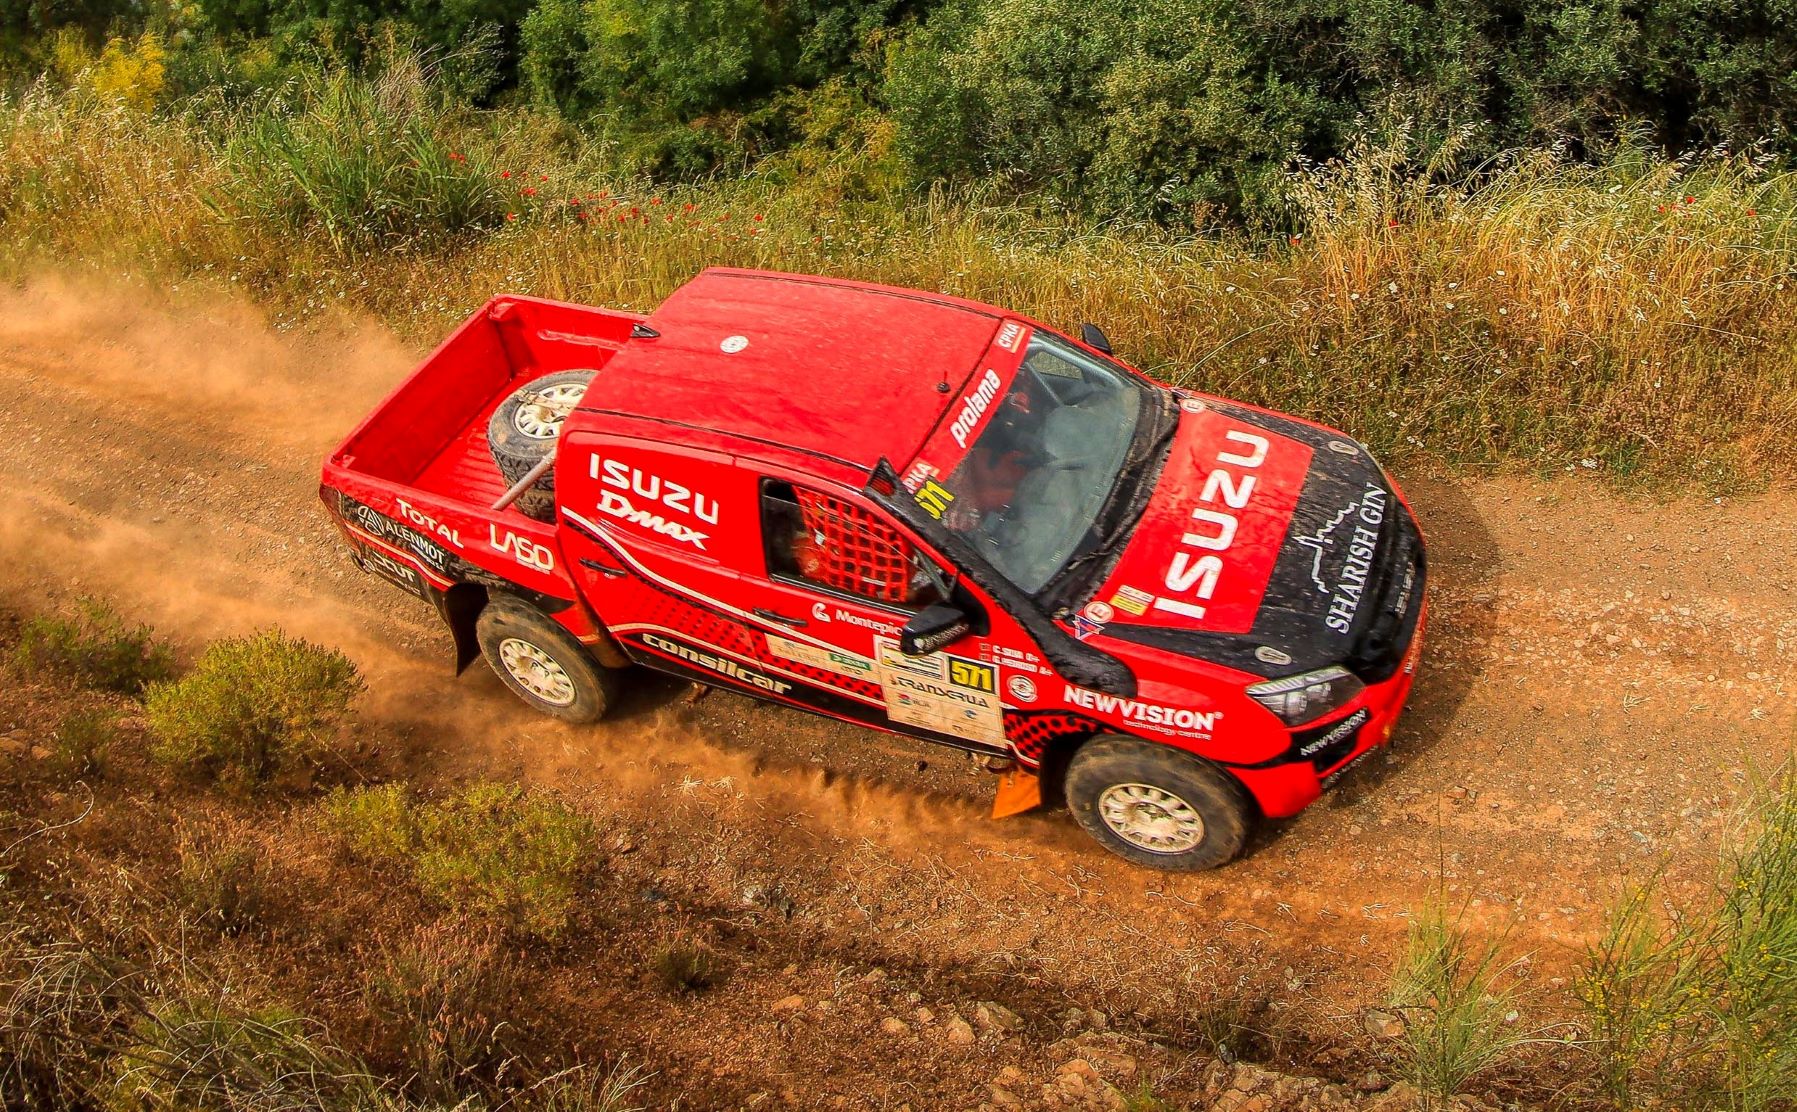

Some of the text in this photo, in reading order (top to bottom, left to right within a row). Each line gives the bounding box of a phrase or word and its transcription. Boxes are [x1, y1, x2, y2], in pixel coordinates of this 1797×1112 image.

[950, 368, 1001, 449] prolama
[589, 453, 719, 525] ISUZU
[901, 462, 932, 495] PKA
[396, 498, 464, 549] TOTAL
[489, 523, 555, 571] LASO
[1153, 430, 1269, 619] ISUZU
[1325, 482, 1388, 634] SHARISH GIN
[642, 633, 792, 694] consilcar
[951, 660, 993, 691] 571
